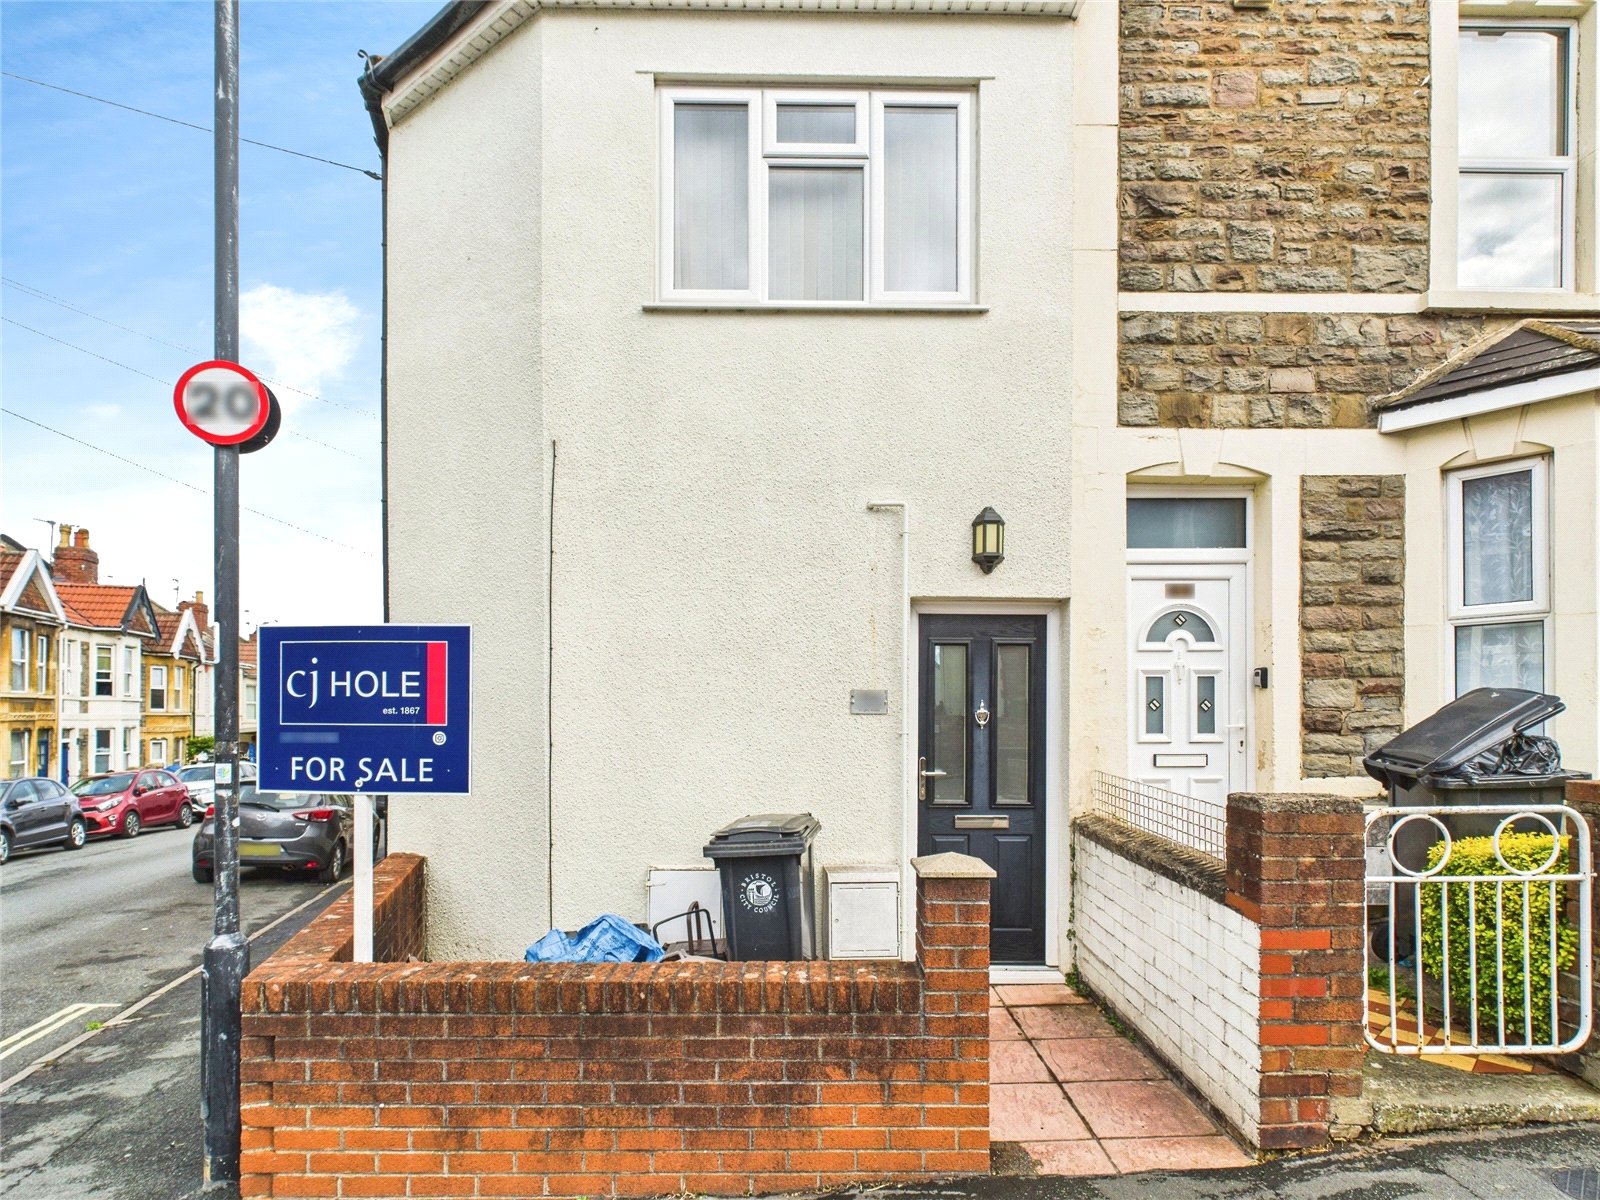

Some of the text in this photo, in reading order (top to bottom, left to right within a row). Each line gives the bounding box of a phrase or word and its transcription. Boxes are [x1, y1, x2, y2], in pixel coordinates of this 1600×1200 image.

[331, 670, 420, 698] HOLE
[383, 707, 420, 715] est. 1867
[291, 756, 434, 783] FOR SALE
[741, 873, 776, 888] BRISTOL
[740, 894, 779, 913] CITY COUNCIL
